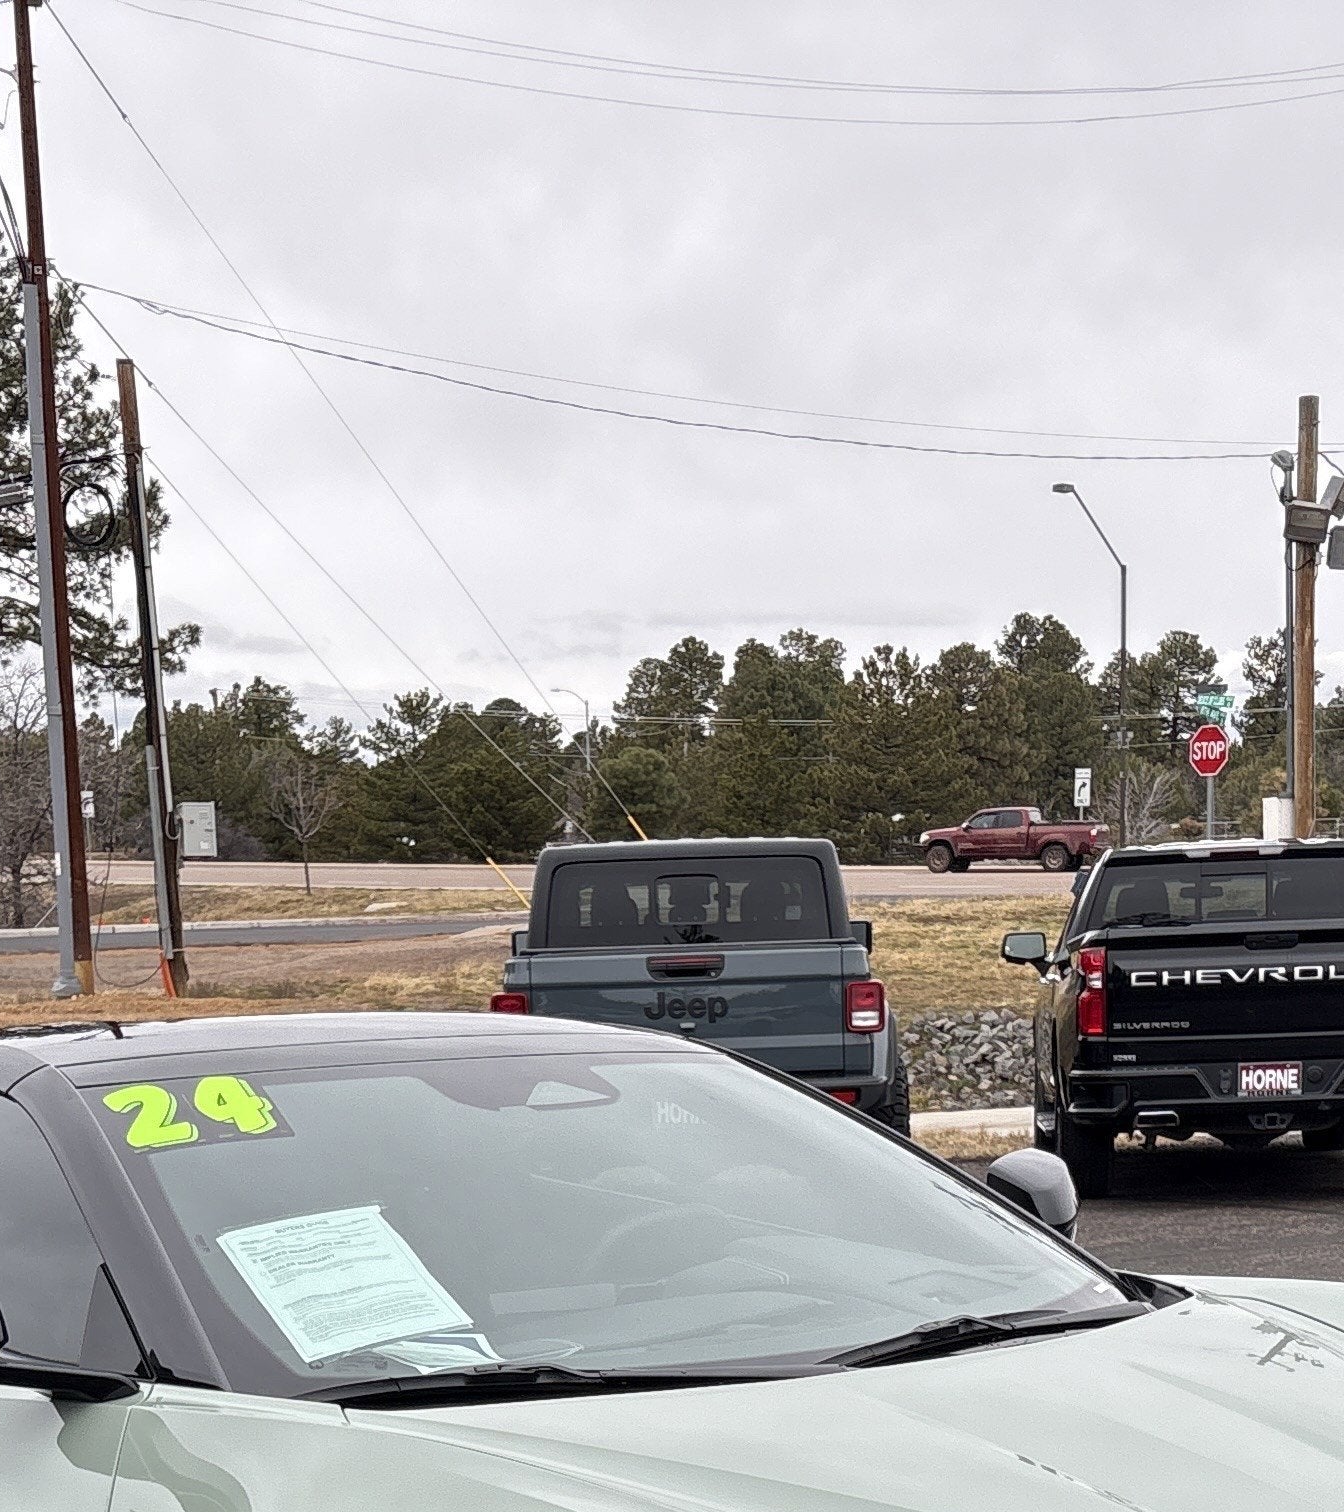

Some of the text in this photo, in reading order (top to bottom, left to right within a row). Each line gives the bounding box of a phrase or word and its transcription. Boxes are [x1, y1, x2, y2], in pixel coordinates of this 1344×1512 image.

[1192, 741, 1225, 760] STOP
[644, 992, 729, 1023] Jeep
[1112, 1021, 1190, 1030] SILVERADO
[1241, 1068, 1299, 1090] HORNE
[102, 1075, 277, 1149] 24
